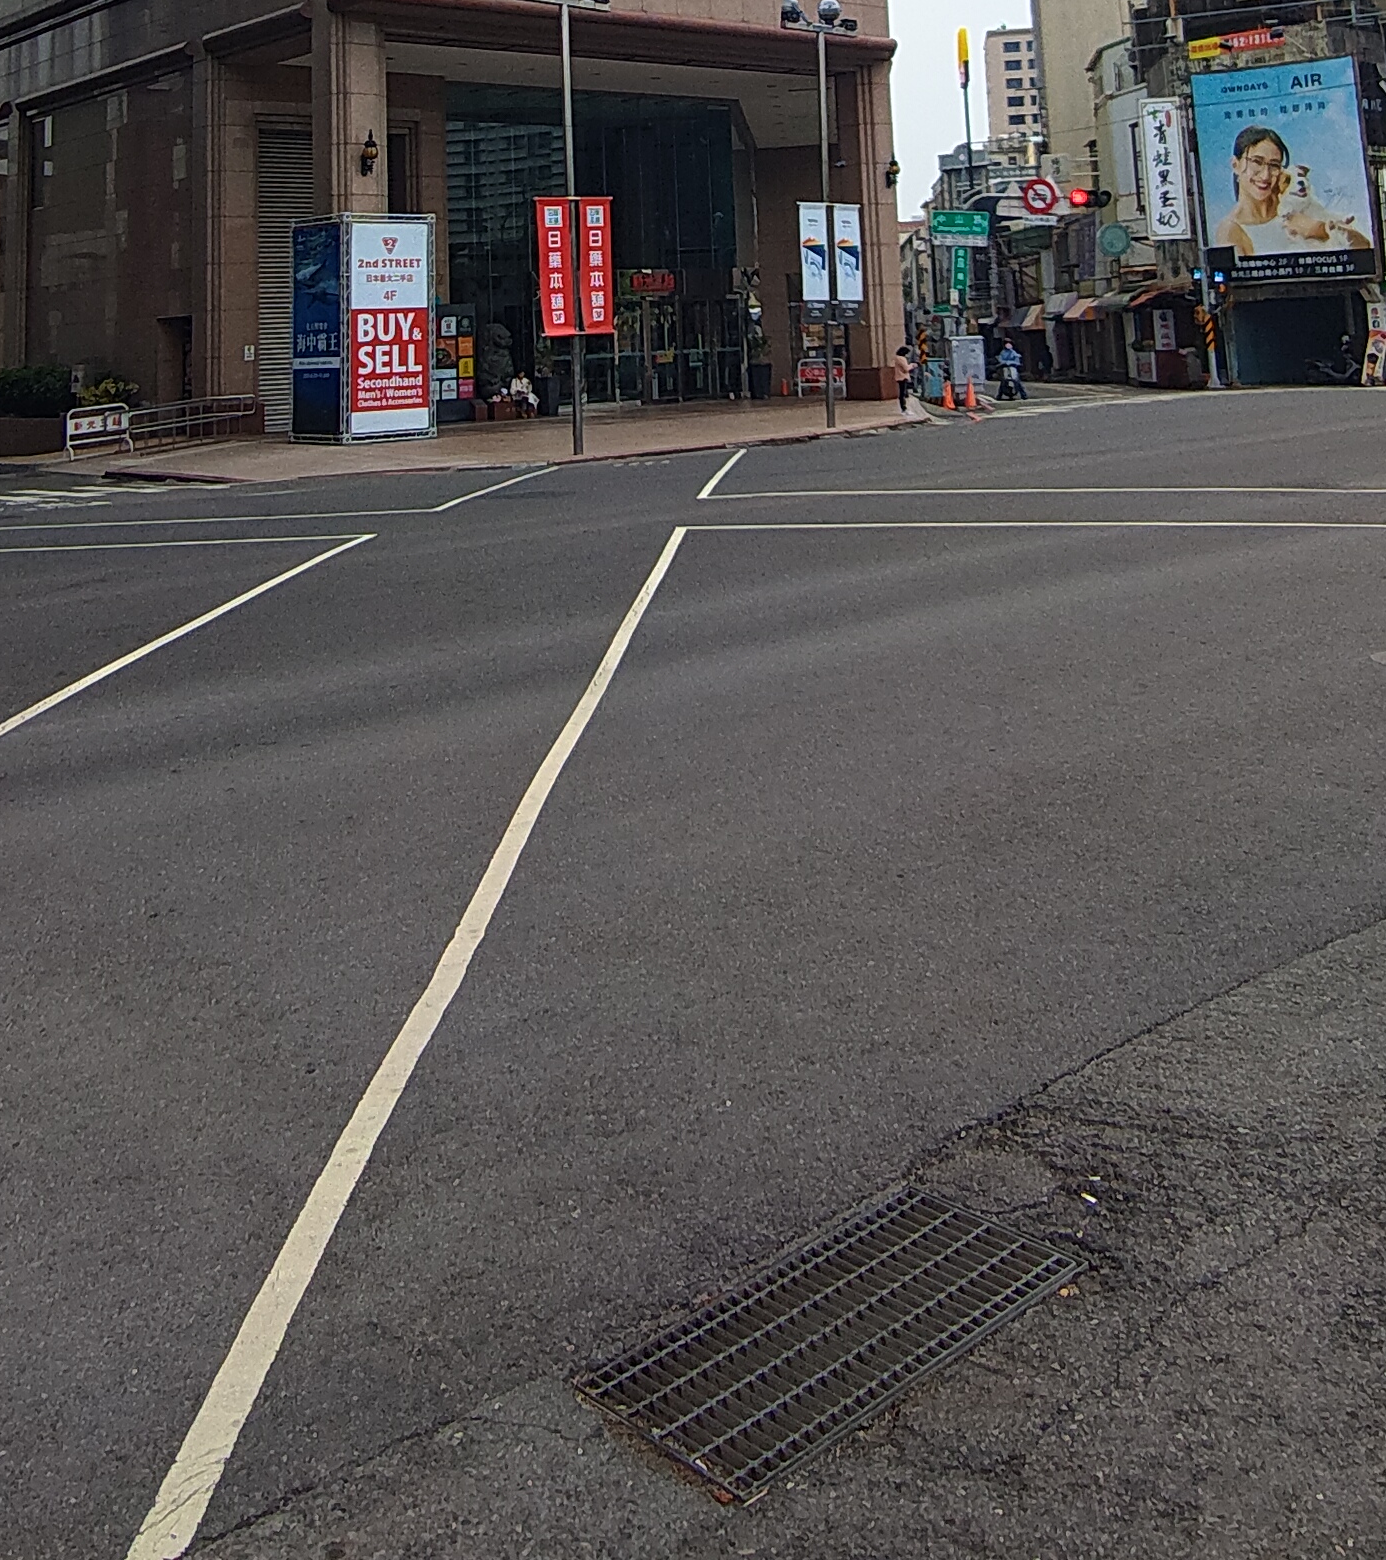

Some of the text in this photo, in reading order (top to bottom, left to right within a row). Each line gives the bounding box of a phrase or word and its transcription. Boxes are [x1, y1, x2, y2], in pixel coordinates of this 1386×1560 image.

[1220, 73, 1323, 95] OWNDAYS AIR
[357, 258, 422, 269] 2nd STREET
[382, 290, 397, 302] 4F
[357, 312, 416, 343] BUY
[357, 344, 423, 375] SELL
[357, 375, 423, 390] Secondhand
